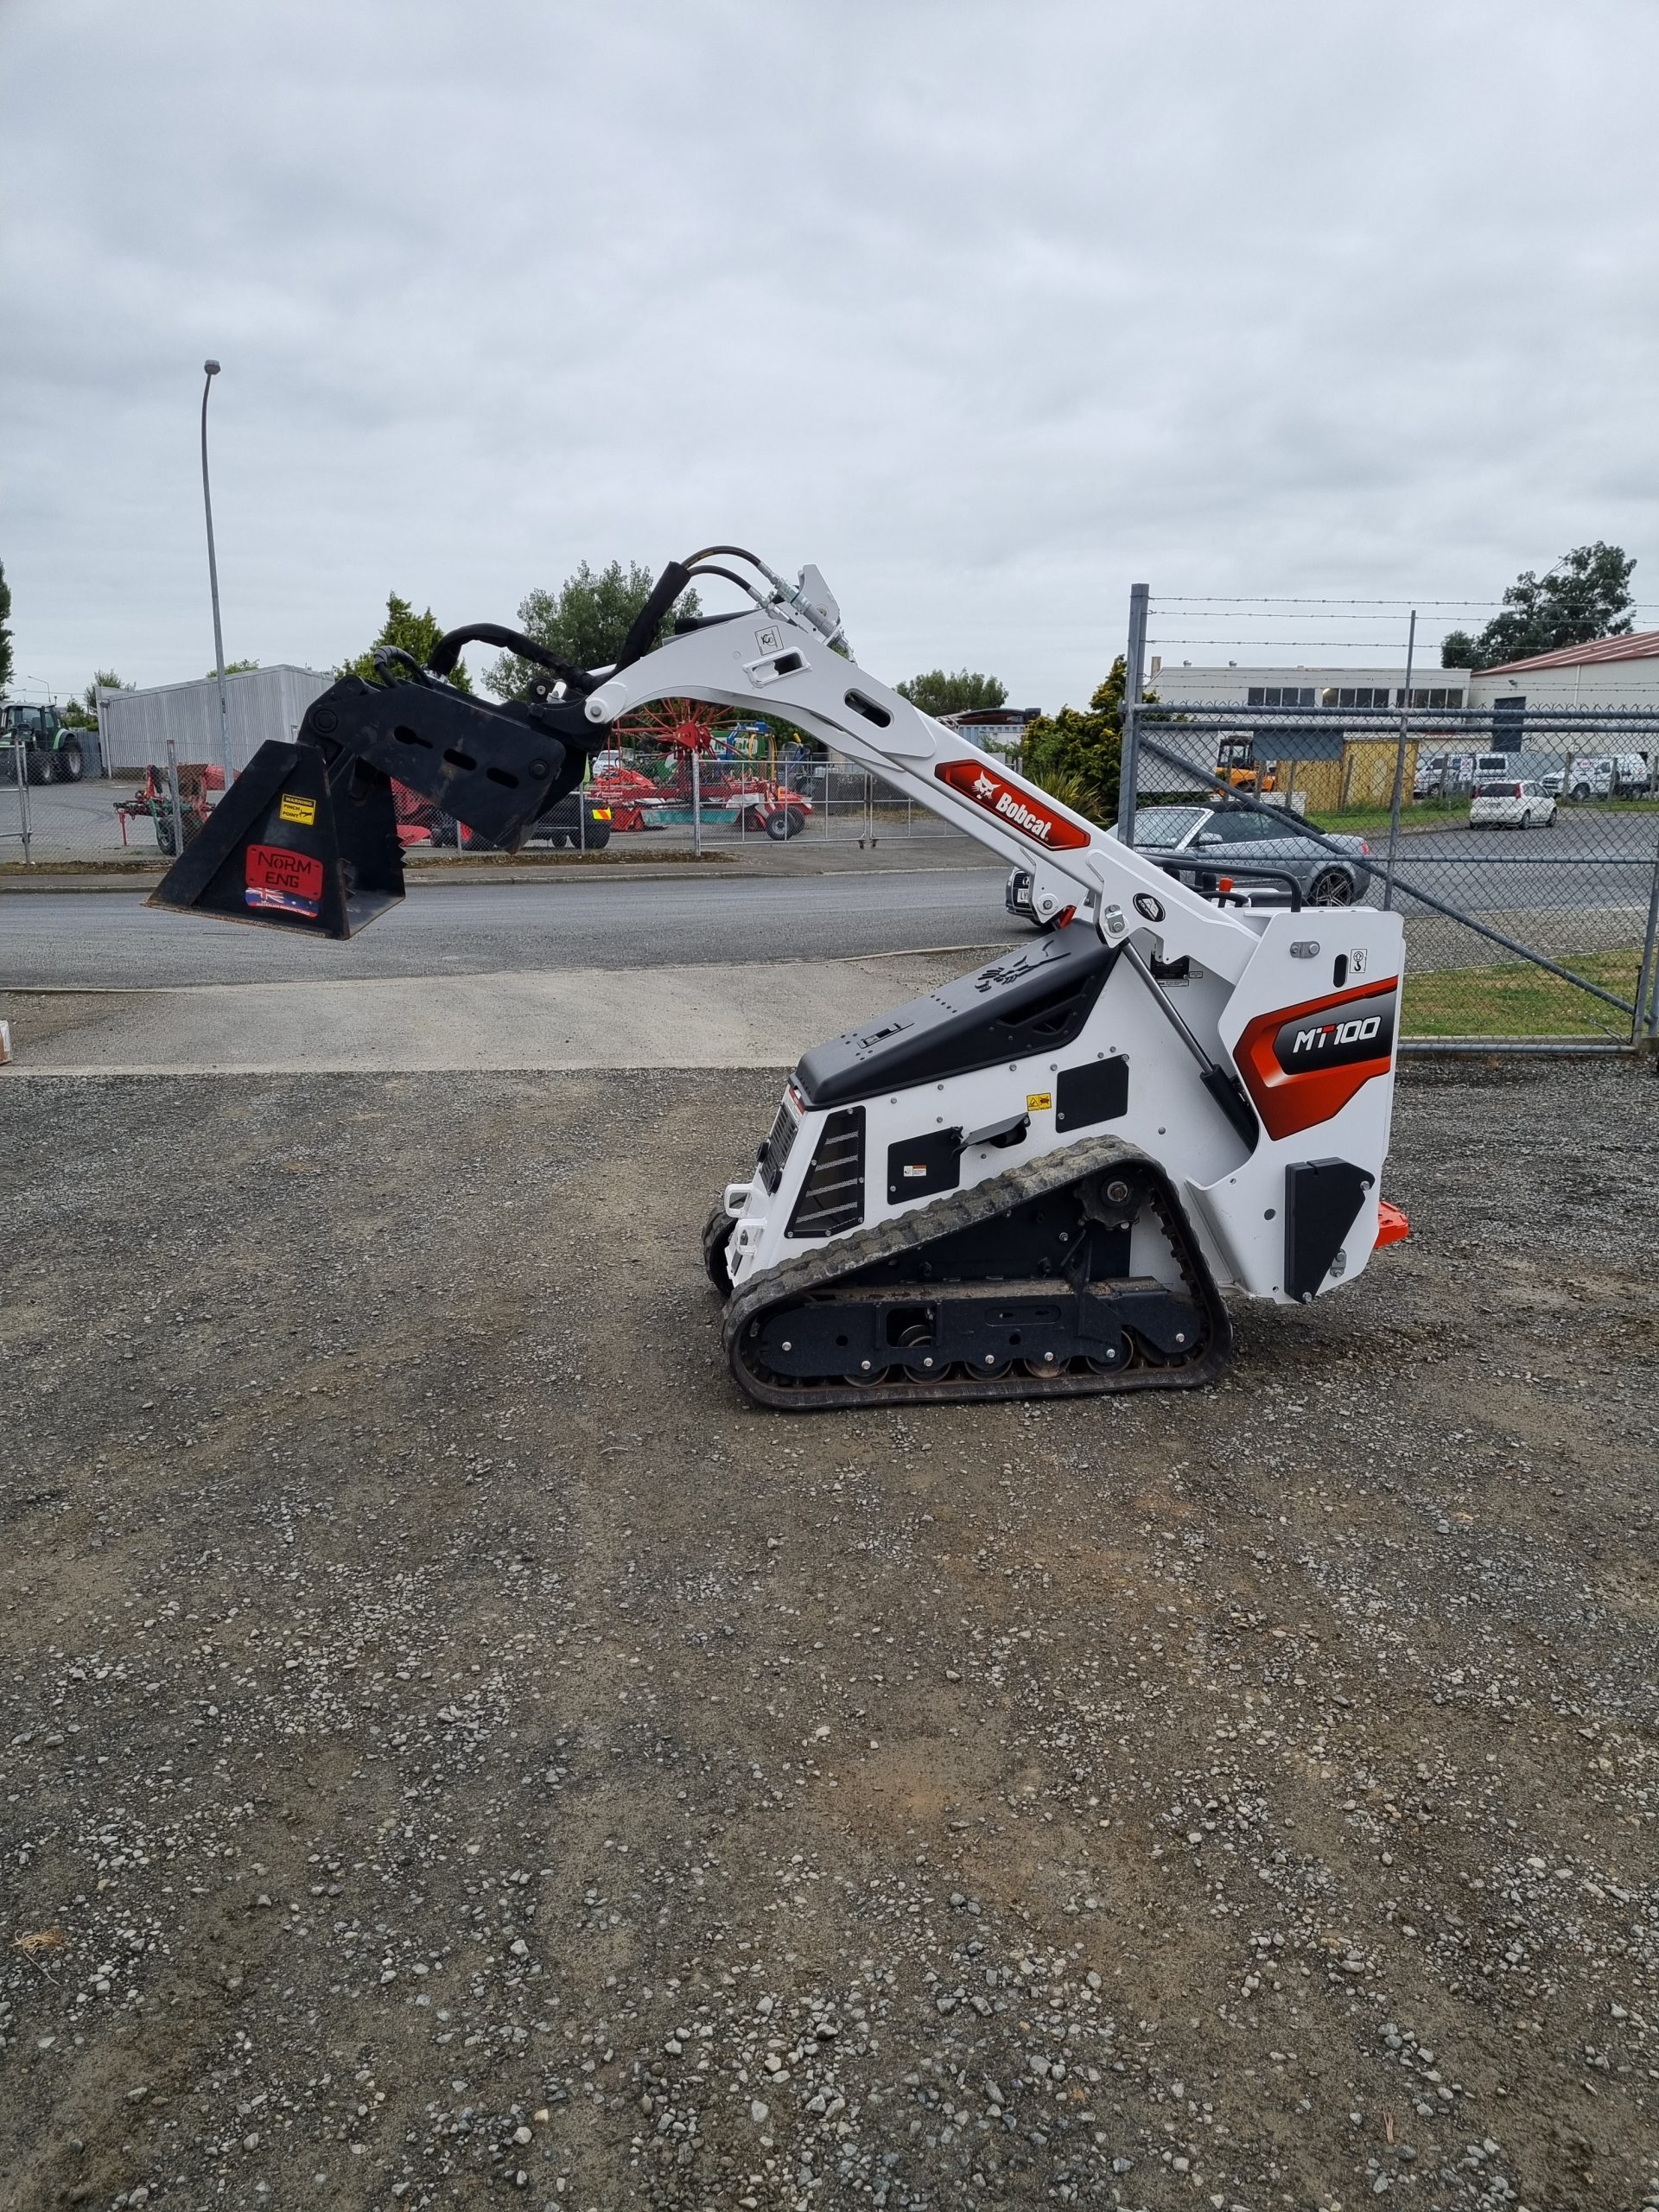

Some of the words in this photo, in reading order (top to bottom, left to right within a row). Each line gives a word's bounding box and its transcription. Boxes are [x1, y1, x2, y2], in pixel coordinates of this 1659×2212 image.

[285, 797, 313, 806] WARNING
[995, 792, 1052, 839] Bobcat
[265, 871, 299, 888] ENG
[1293, 1016, 1382, 1053] MT100
